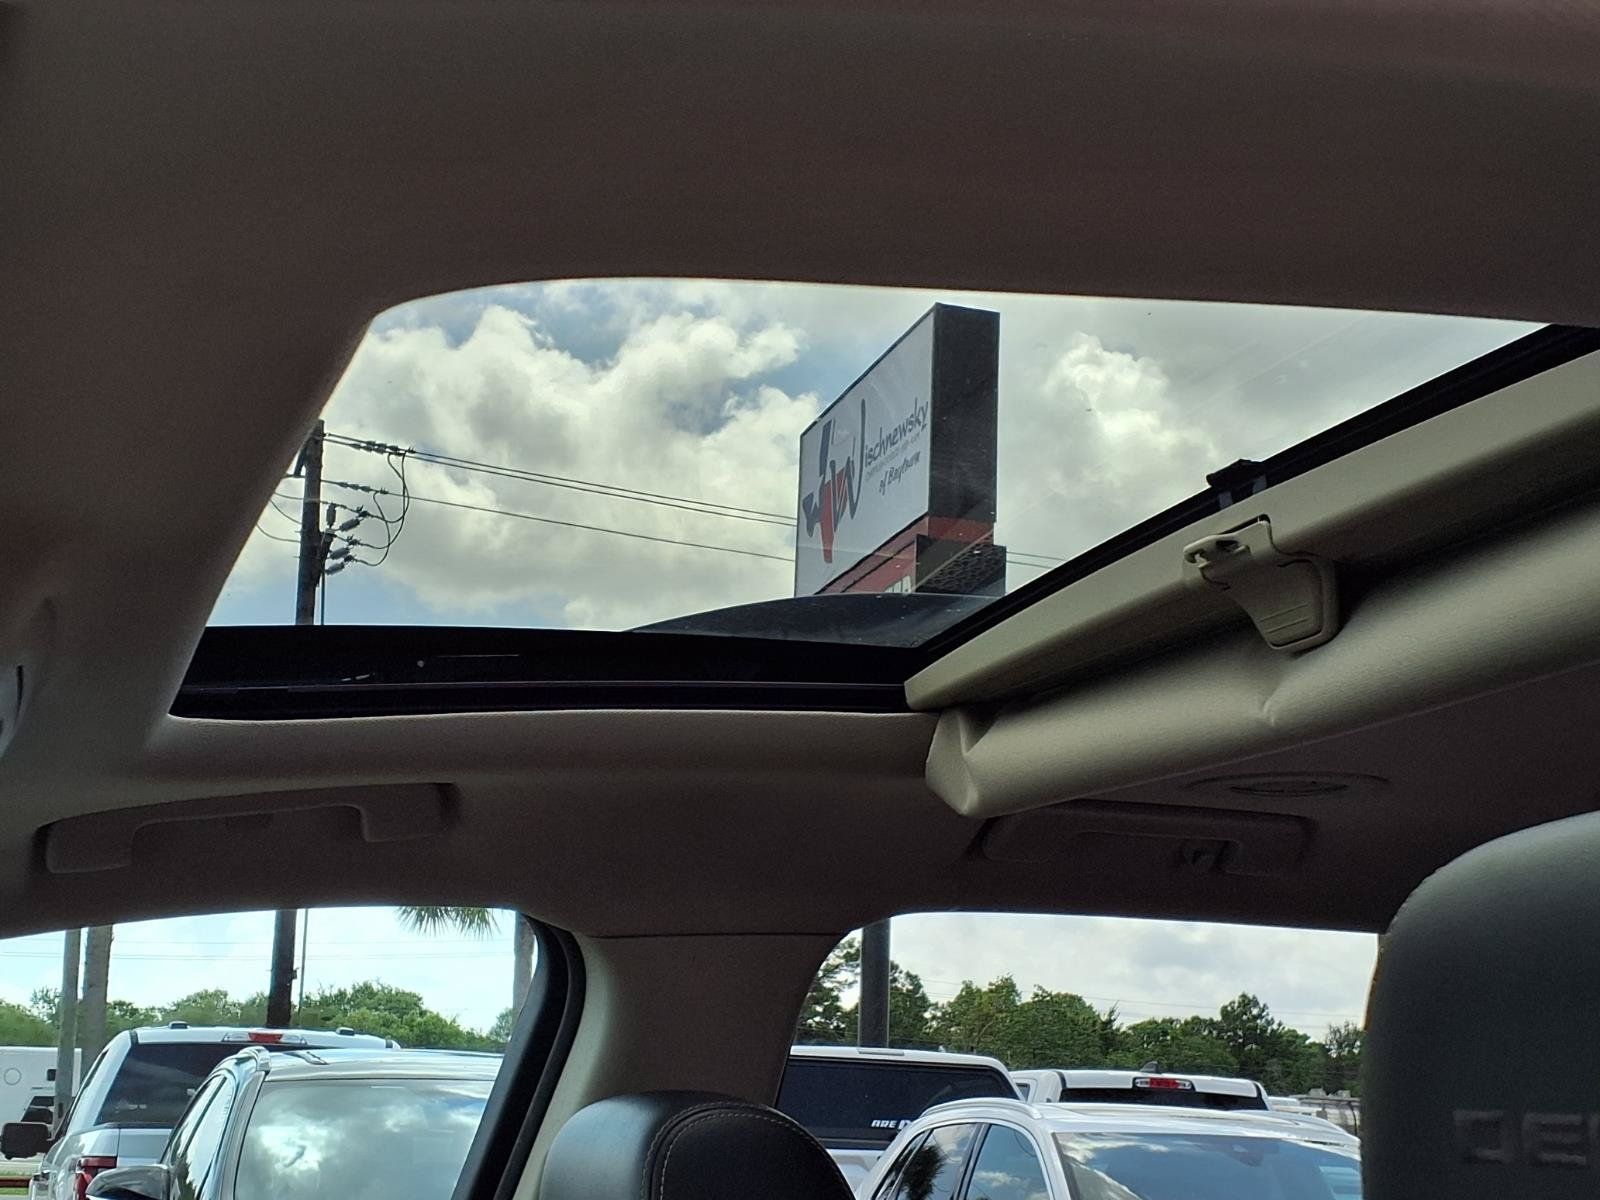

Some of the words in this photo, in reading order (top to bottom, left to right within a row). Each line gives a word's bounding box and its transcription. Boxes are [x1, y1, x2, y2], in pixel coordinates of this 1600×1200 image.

[828, 397, 928, 533] Wischnewsky
[879, 470, 889, 496] of
[1453, 1110, 1599, 1165] DE
